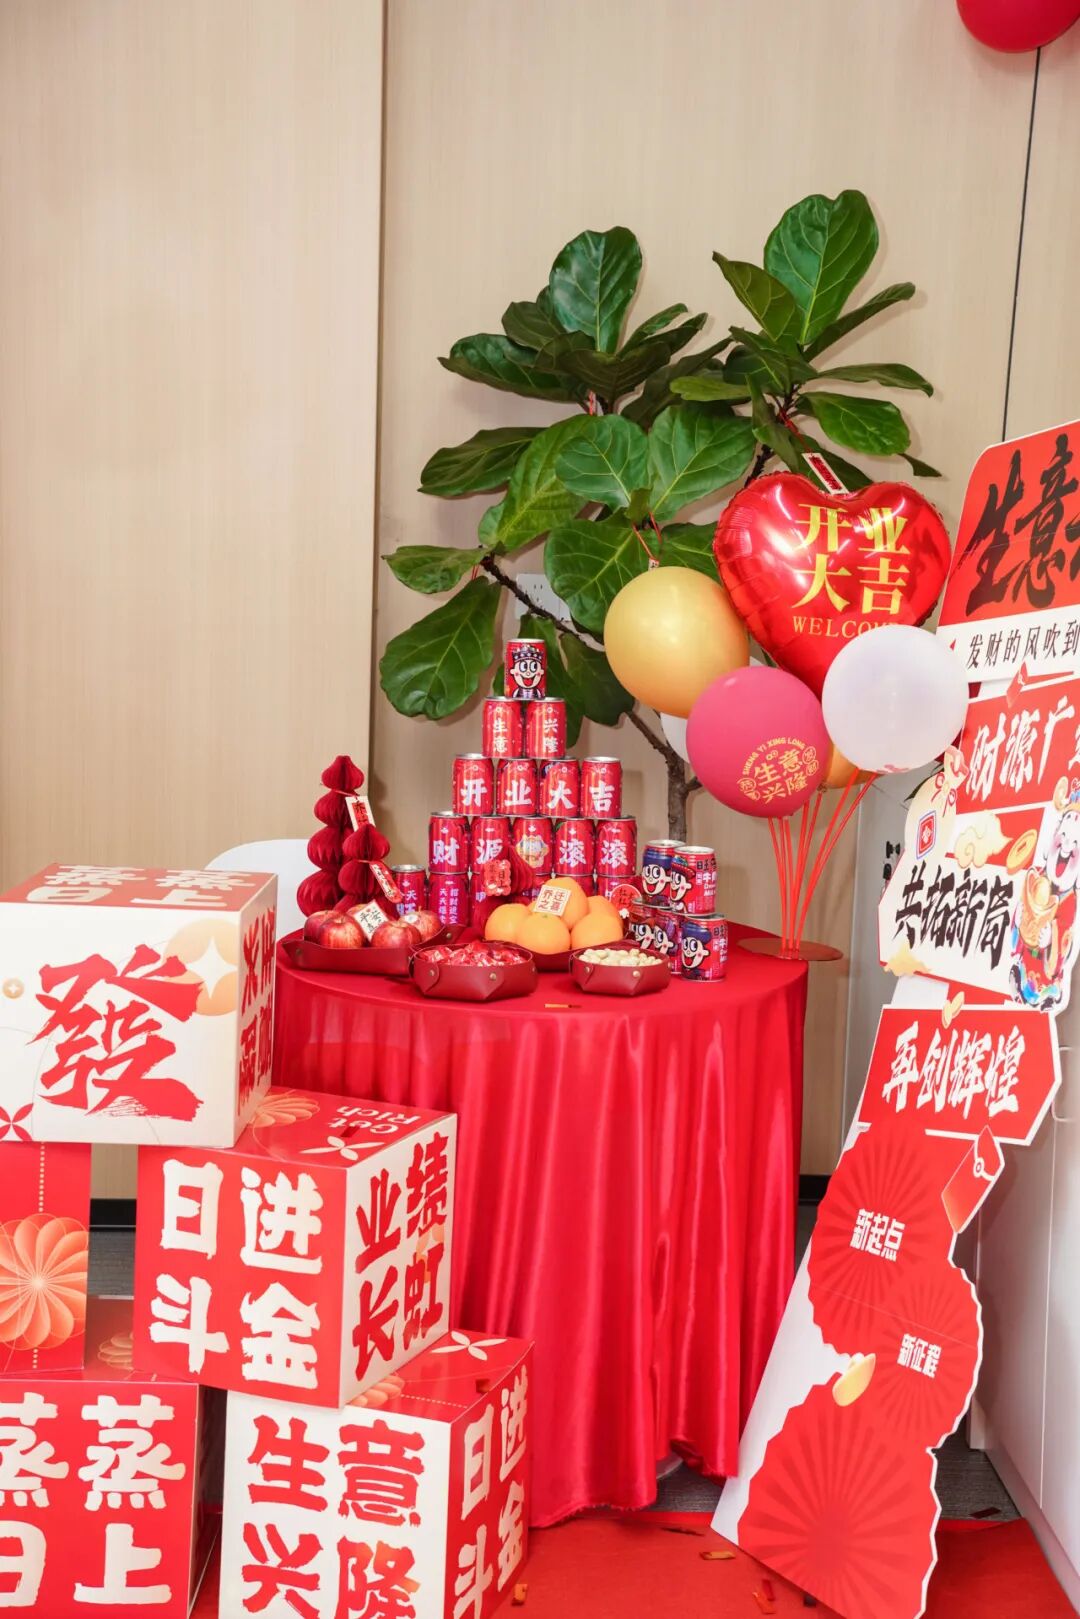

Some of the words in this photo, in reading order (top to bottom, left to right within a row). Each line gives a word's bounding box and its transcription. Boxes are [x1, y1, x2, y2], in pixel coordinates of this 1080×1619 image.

[796, 503, 910, 556] 开业
[950, 433, 1080, 617] 生意
[791, 554, 909, 615] 大吉
[793, 616, 899, 638] WELCO
[967, 620, 1080, 669] 发财的风吹到
[754, 749, 803, 786] 生意
[757, 744, 767, 752] YI
[767, 737, 786, 747] XING
[762, 771, 808, 804] 兴隆
[26, 886, 228, 907] 日上
[893, 859, 1013, 970] 共拓新局
[25, 944, 204, 1122] 發
[882, 1020, 1025, 1119] 再创辉煌
[336, 1105, 421, 1125] Rich
[160, 1158, 323, 1275] 日进
[355, 1132, 449, 1273] 业绩
[850, 1209, 905, 1262] 新起点
[149, 1273, 322, 1389] 斗金
[352, 1242, 444, 1381] 长虹
[897, 1333, 941, 1378] 新征程
[247, 1415, 425, 1527] 生意
[461, 1365, 528, 1520] 日进
[242, 1522, 421, 1619] 兴隆
[453, 1480, 525, 1619] 斗金
